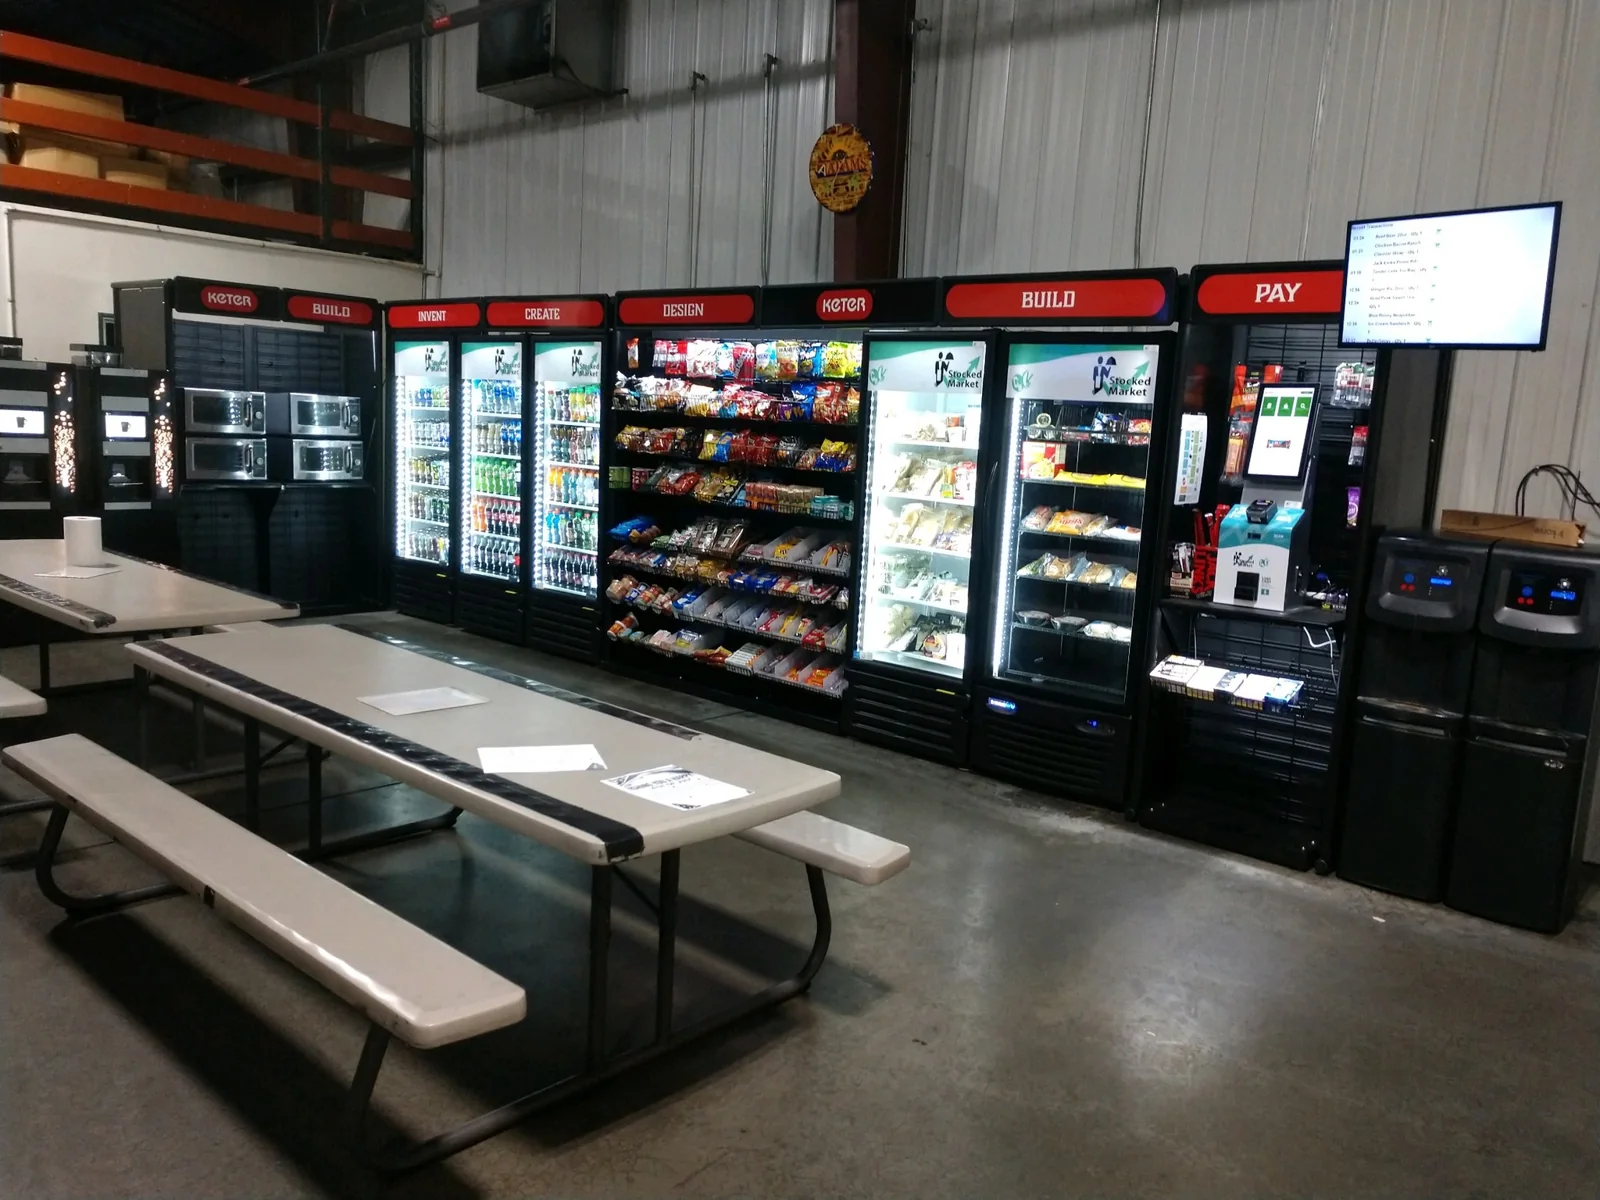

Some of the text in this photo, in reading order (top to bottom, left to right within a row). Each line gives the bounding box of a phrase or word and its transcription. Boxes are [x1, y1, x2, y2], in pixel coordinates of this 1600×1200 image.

[207, 291, 252, 307] KETER
[1021, 290, 1076, 308] BUILD
[1254, 282, 1302, 303] PAY
[312, 303, 351, 318] BUILD
[663, 303, 704, 317] DESIGN
[822, 297, 866, 313] KETER
[418, 310, 447, 322] INVENT
[524, 307, 560, 320] CREATE
[948, 369, 983, 379] Stocked
[1108, 375, 1152, 386] Stocked
[947, 379, 980, 389] Market
[1108, 386, 1148, 397] Market
